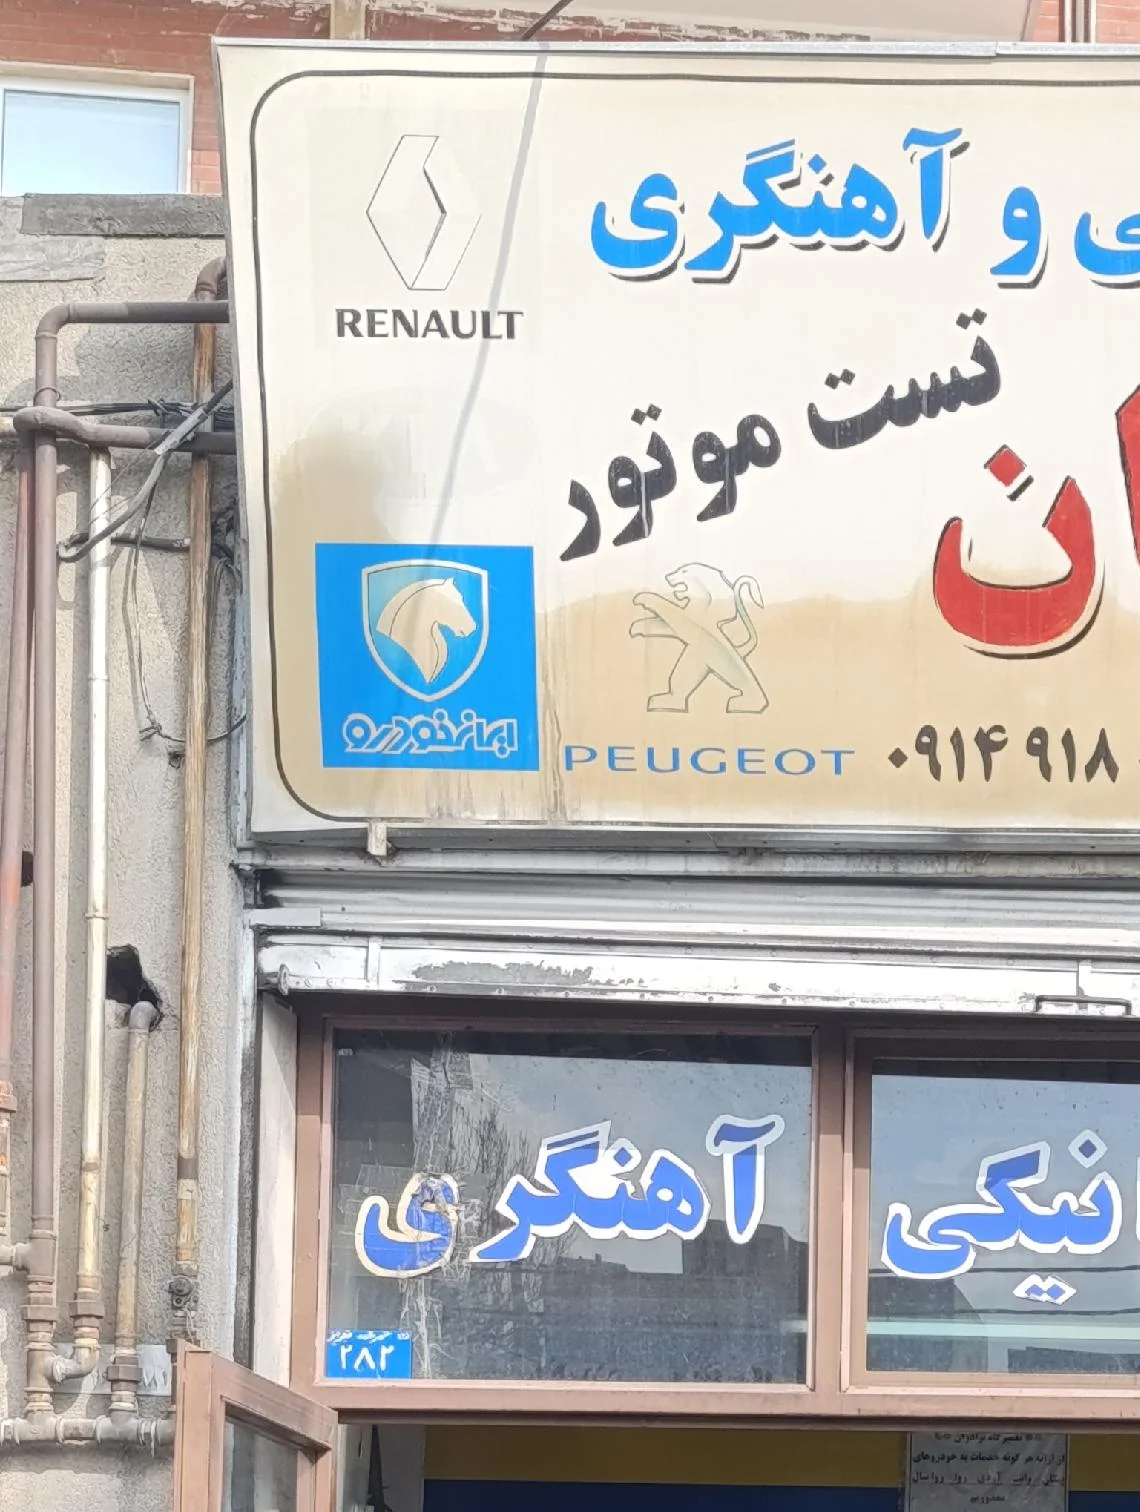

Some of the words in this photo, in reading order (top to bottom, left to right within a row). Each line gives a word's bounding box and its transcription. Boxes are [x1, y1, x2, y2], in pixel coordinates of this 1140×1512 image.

[590, 126, 971, 285] آهنگری
[989, 182, 1049, 288] و
[334, 307, 525, 340] RENAULT
[806, 307, 1003, 451] تست
[558, 403, 783, 562] موتور
[563, 744, 856, 777] PEUGEOT
[353, 1113, 786, 1280] آهنگری
